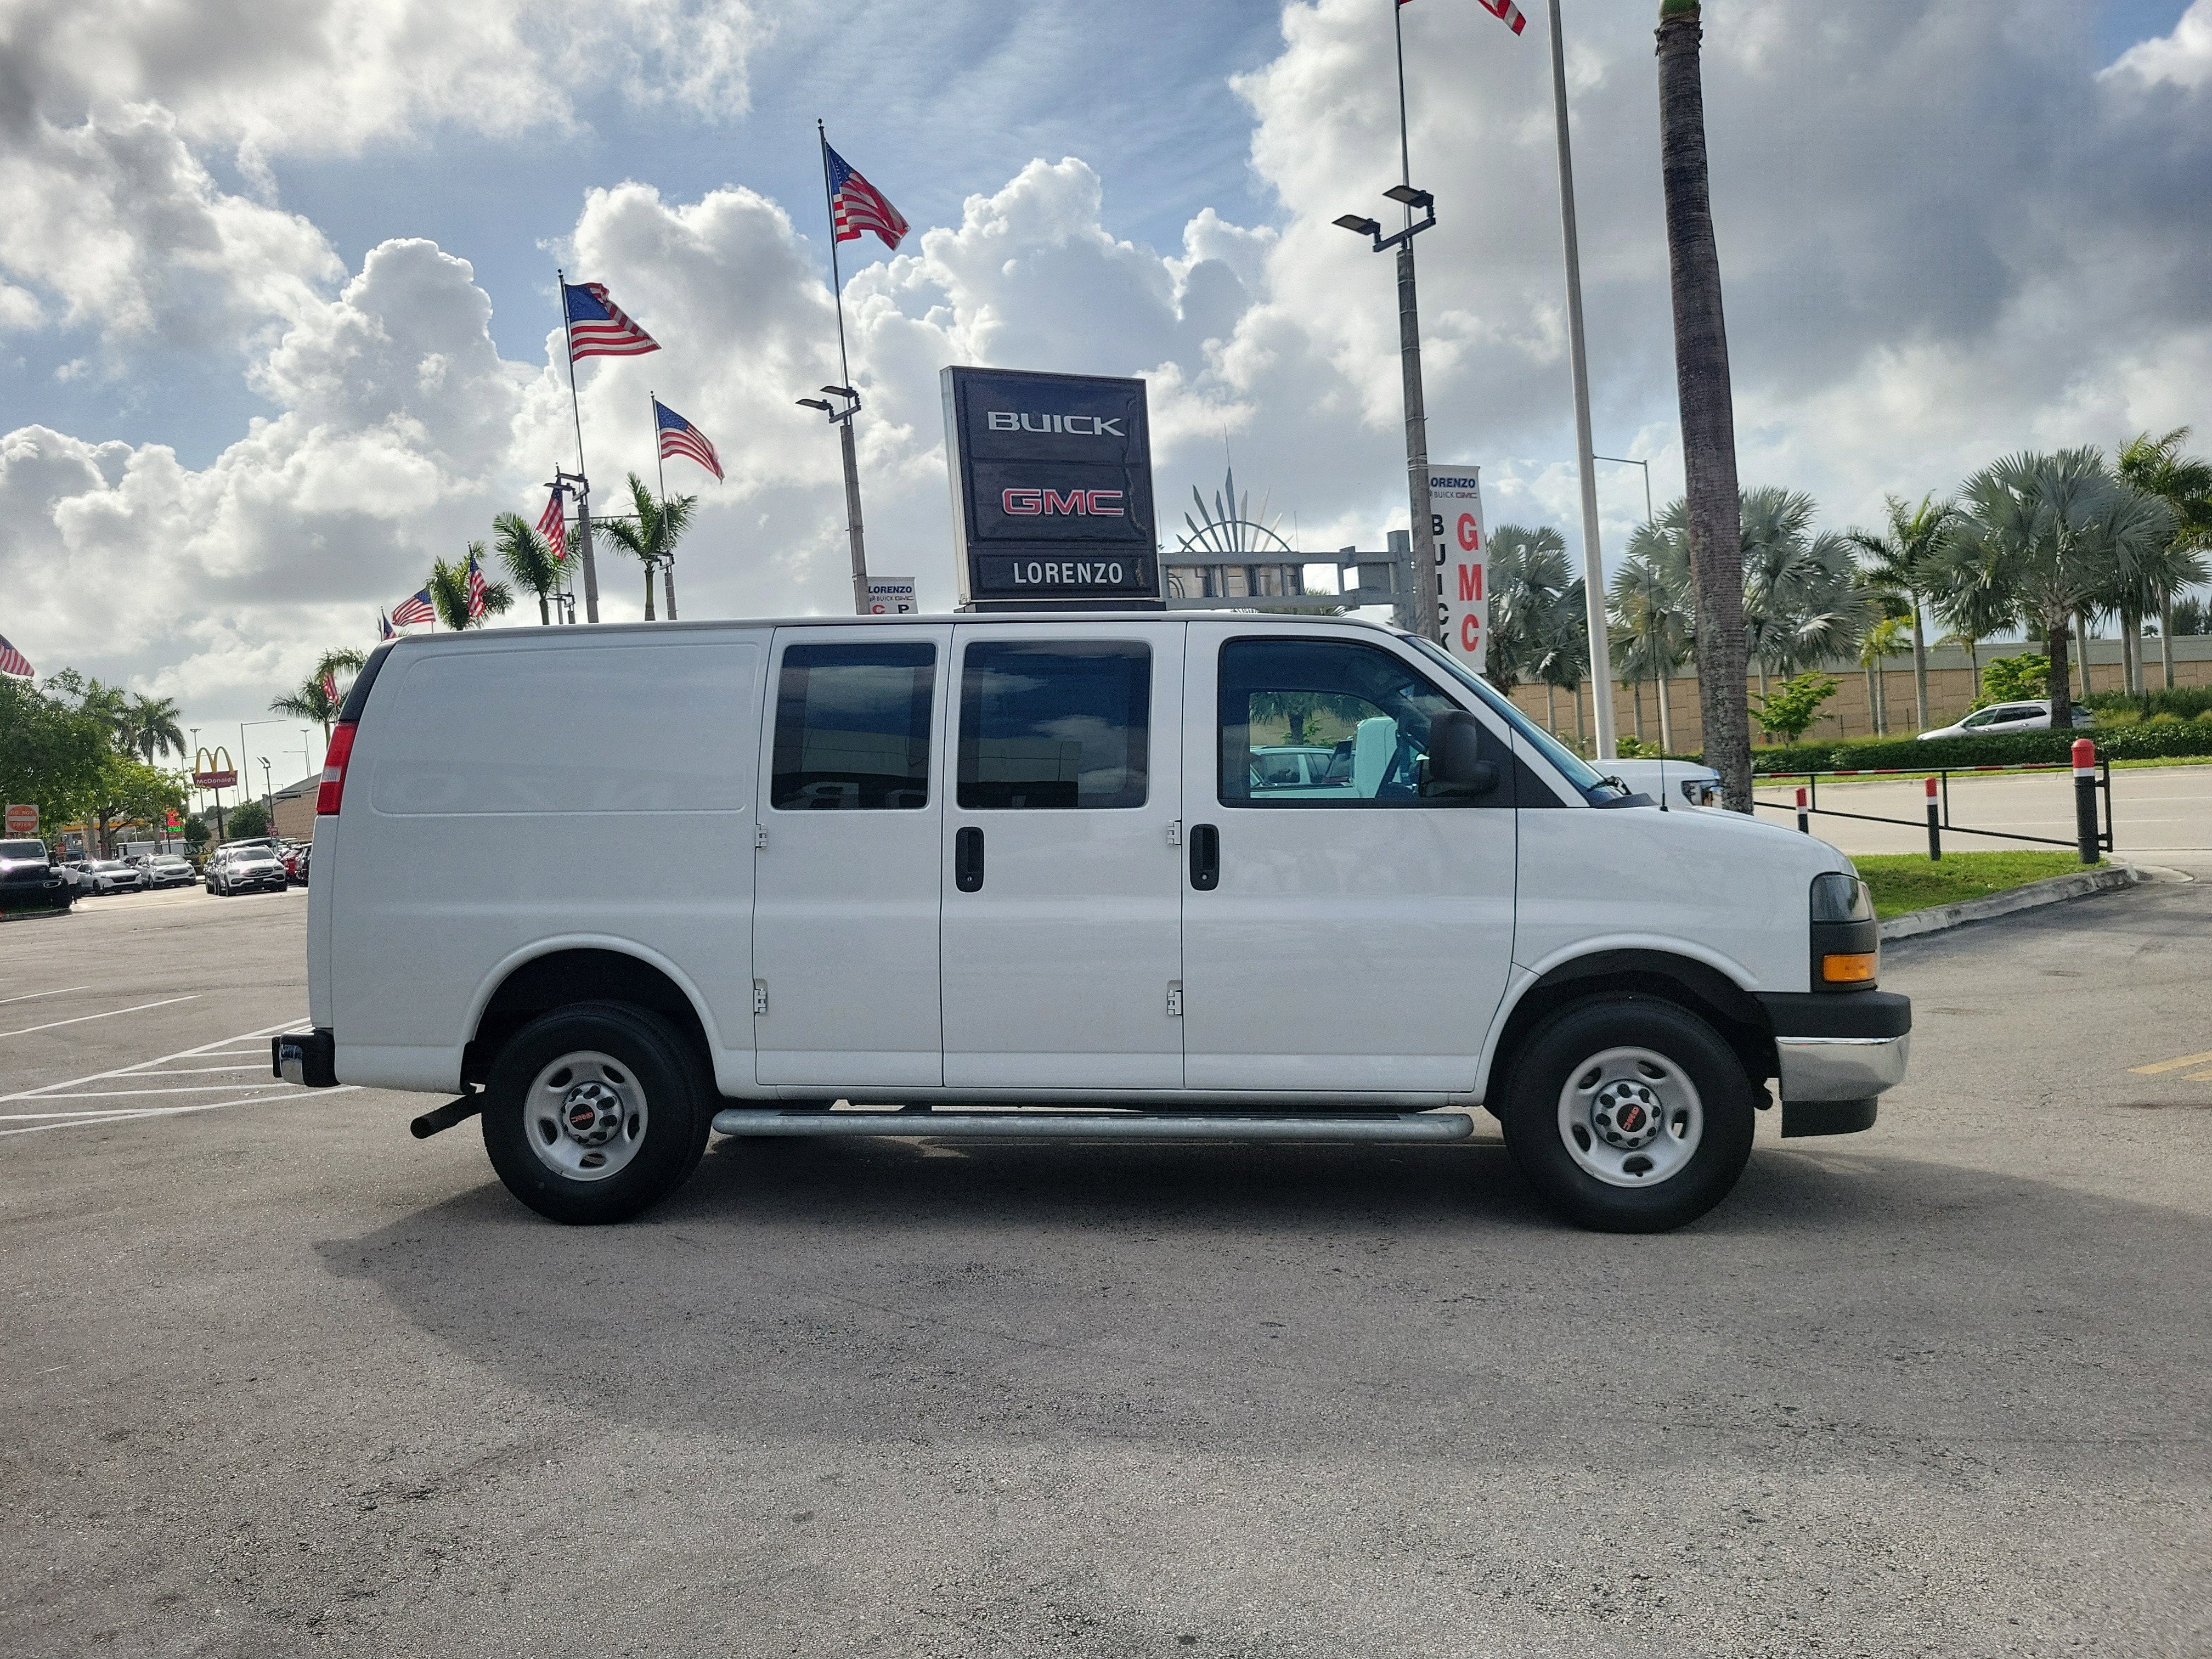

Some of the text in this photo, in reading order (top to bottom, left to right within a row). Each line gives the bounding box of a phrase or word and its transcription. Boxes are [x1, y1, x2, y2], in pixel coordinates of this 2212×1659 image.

[988, 411, 1125, 437] BUICK
[1431, 477, 1475, 488] ORENZO
[1002, 488, 1124, 516] GMC
[1013, 562, 1123, 584] LORENZO
[1457, 512, 1482, 652] GMC
[868, 585, 912, 594] LORENZO
